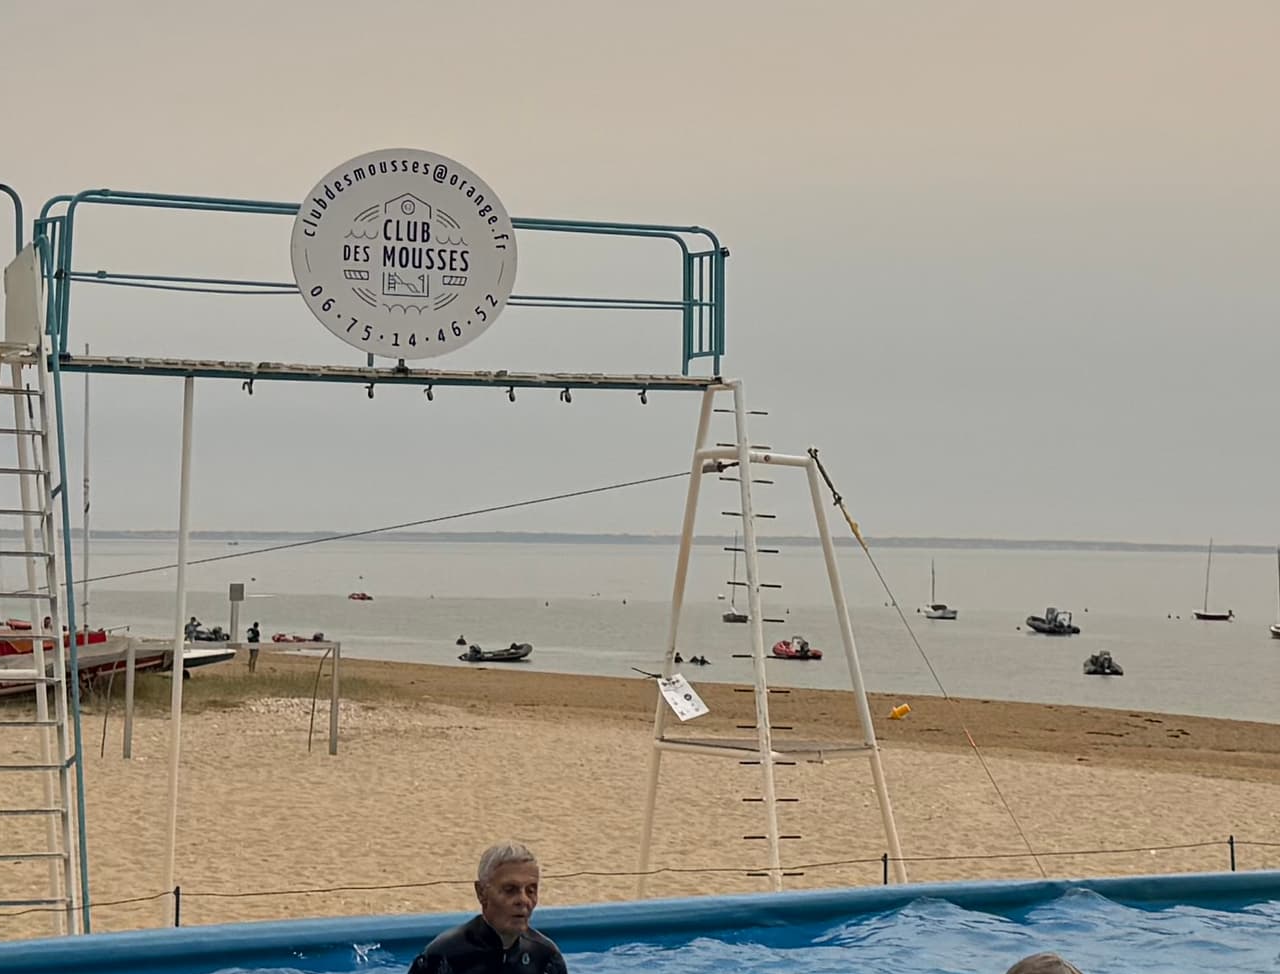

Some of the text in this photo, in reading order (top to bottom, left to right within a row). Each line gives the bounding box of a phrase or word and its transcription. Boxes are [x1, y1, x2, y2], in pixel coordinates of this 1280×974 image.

[303, 160, 508, 250] clubdesmousses@orange.fr
[383, 219, 430, 243] CLUB
[343, 244, 469, 271] DES MOUSSES
